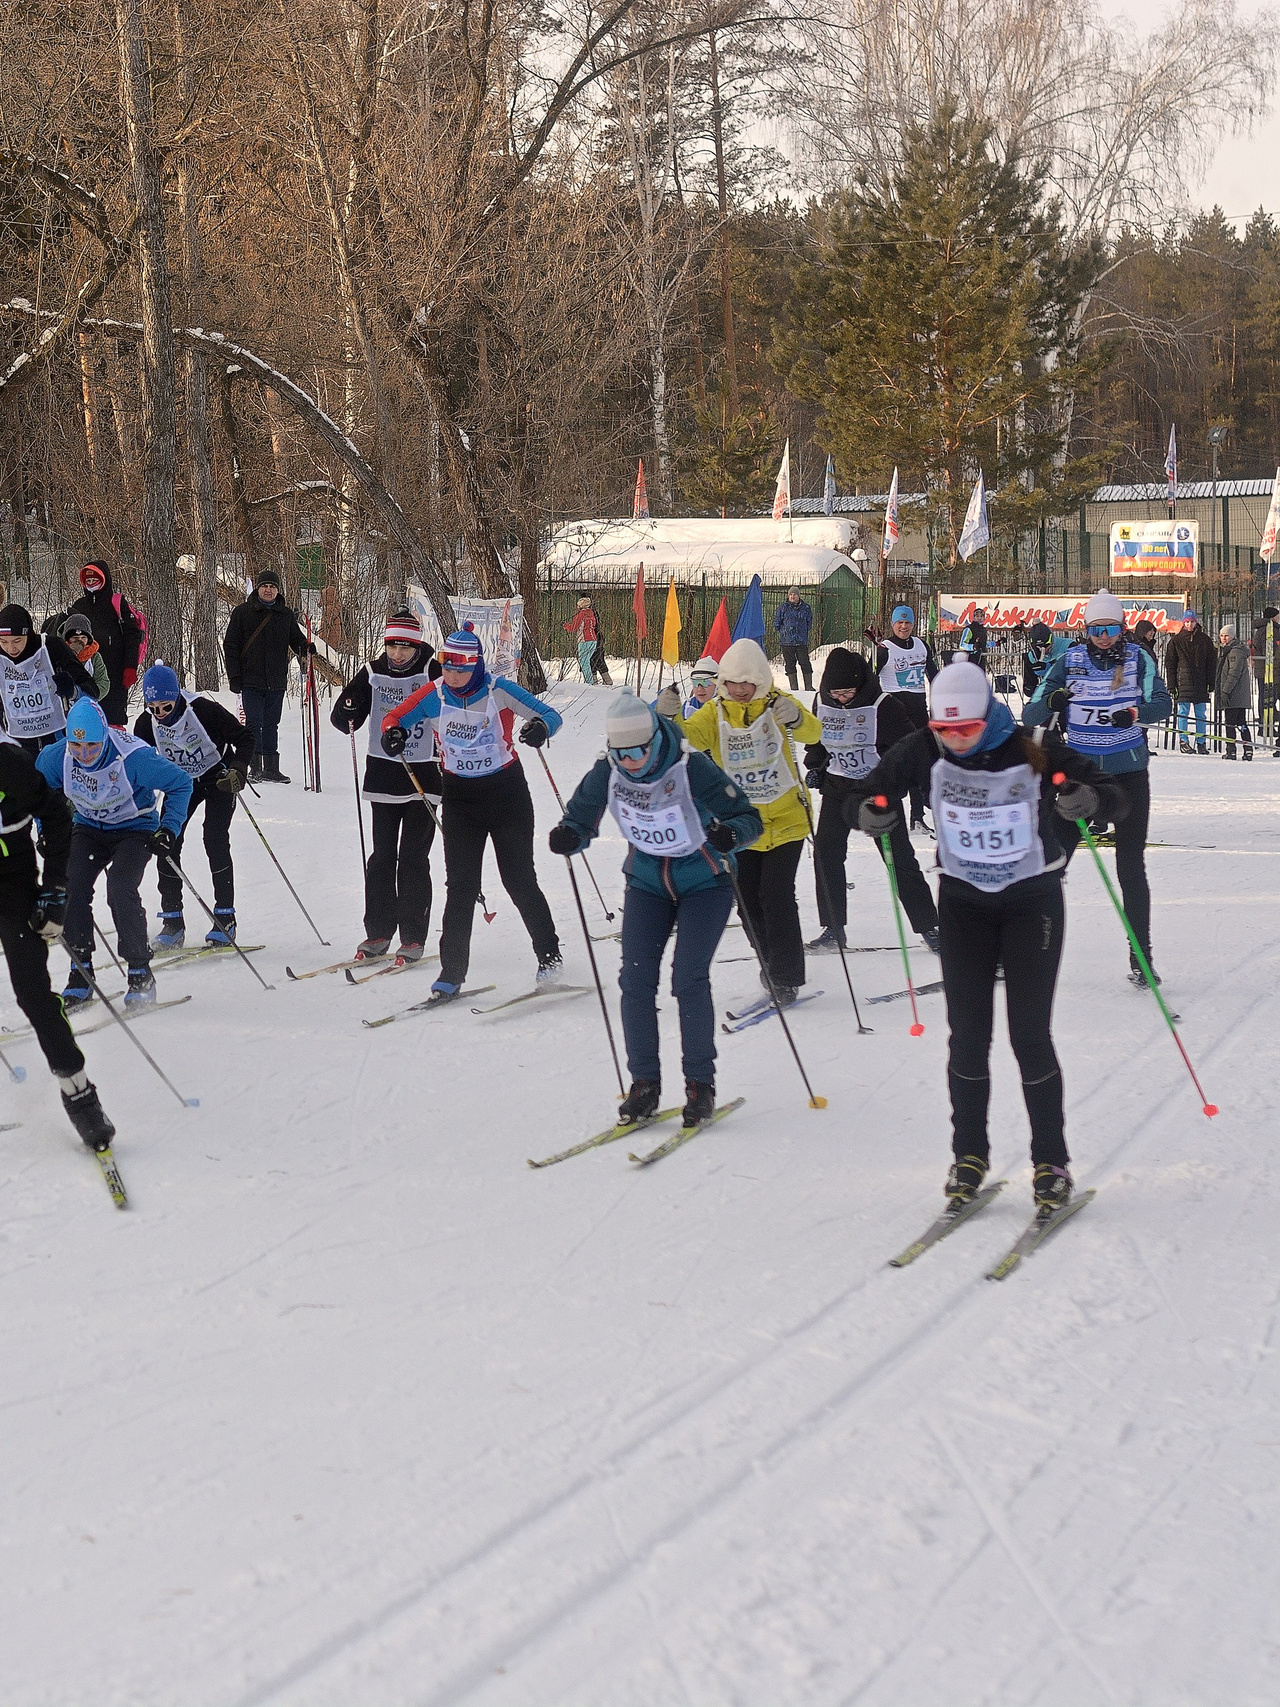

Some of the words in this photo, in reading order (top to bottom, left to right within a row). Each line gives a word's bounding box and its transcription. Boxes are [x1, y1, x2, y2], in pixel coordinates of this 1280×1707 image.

[1159, 561, 1186, 570] СПОРТУ
[12, 692, 43, 709] 8160
[446, 720, 478, 733] ЛЫЖНЯ
[445, 728, 477, 741] РОССИИ
[456, 757, 492, 771] 8078
[630, 825, 676, 845] 8200
[959, 828, 1015, 850] 8151
